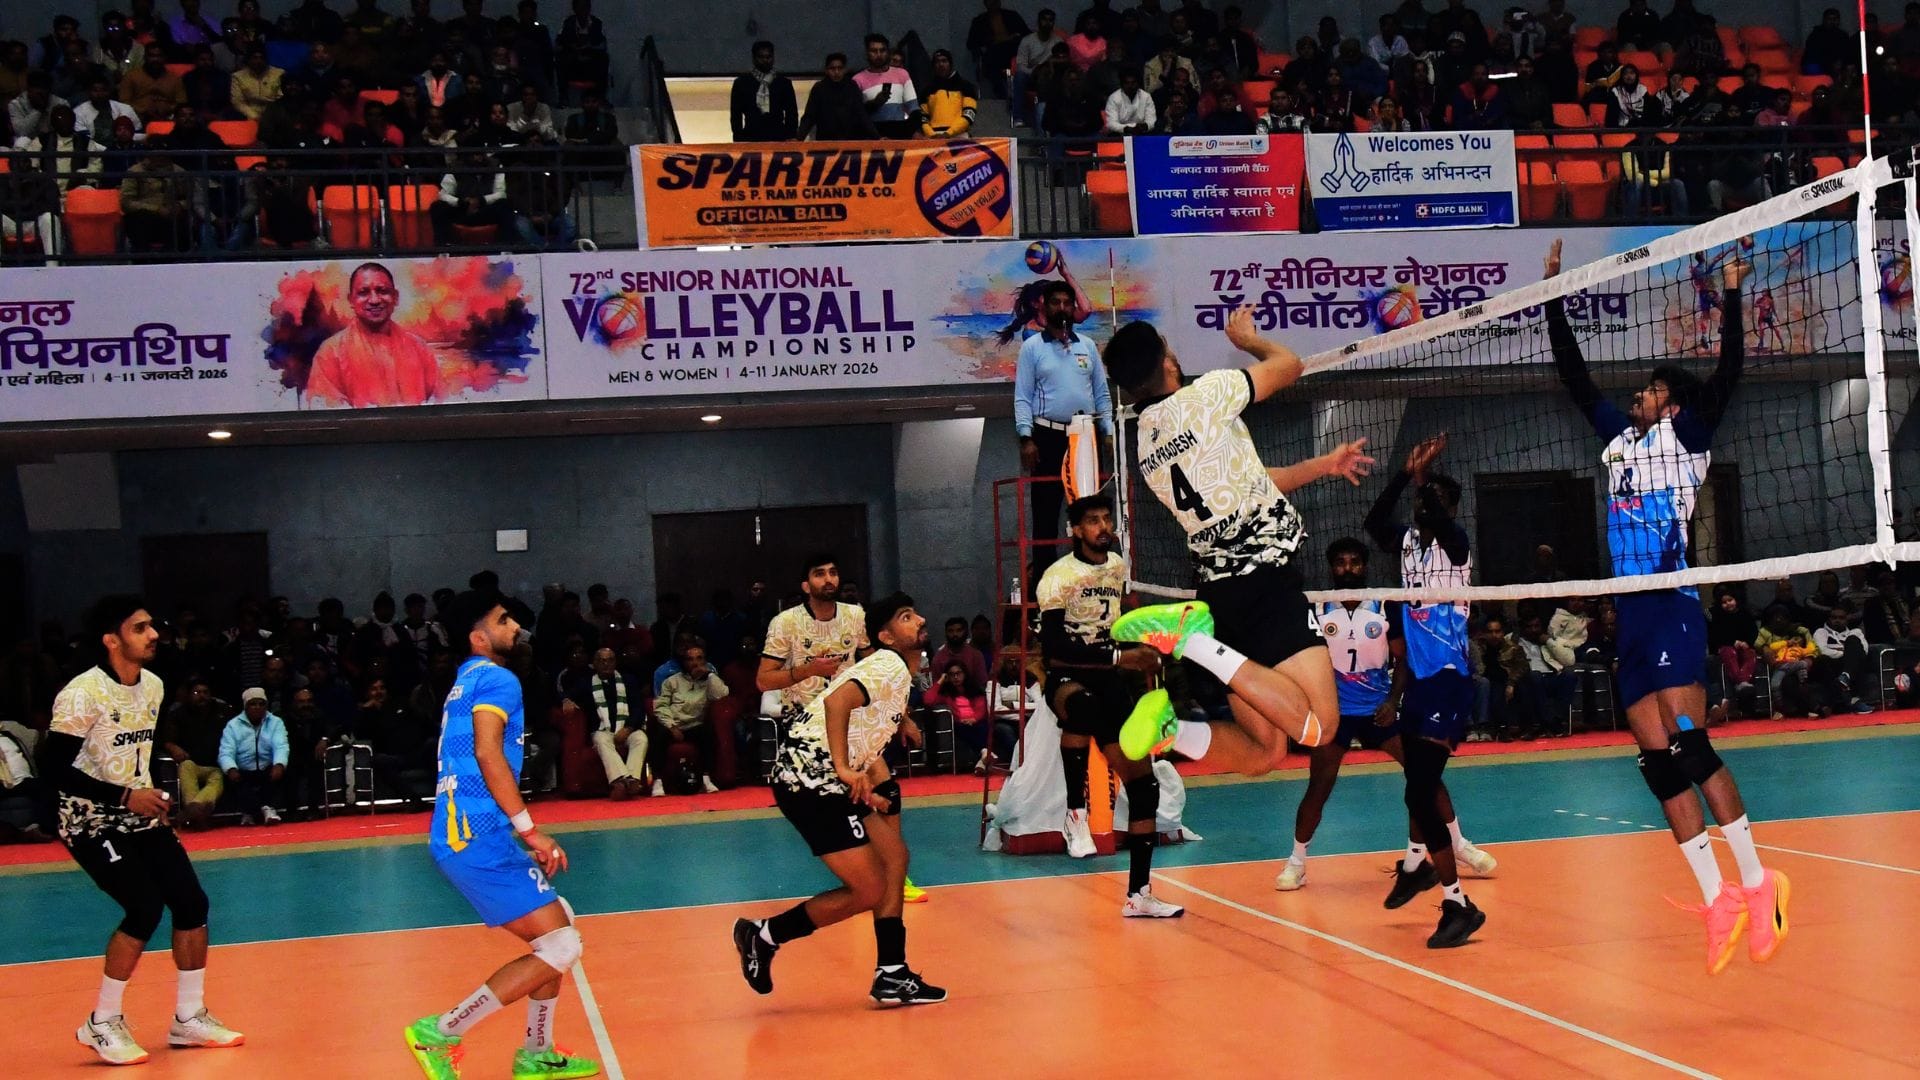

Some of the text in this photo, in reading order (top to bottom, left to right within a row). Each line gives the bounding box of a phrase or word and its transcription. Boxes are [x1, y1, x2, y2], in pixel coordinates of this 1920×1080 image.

[1368, 133, 1491, 153] Welcomes You
[657, 148, 905, 190] SPARTAN
[1370, 160, 1492, 185] हार्दिक अभिनन्दन
[721, 186, 896, 201] M/S P. RAM CHAND & CO.
[933, 163, 993, 211] SPARTAN
[1147, 184, 1296, 200] आपका हार्दिक स्वागत एवं
[1811, 177, 1845, 198] SPARTAN
[702, 205, 843, 224] OFFICIAL BALL
[1170, 202, 1276, 218] अभिनंदन करता है
[1431, 205, 1484, 215] HDFC BANK
[569, 266, 853, 295] 72nd SENIOR NATIONAL
[1263, 257, 1387, 291] सीनियर
[1394, 256, 1508, 286] नेशनल
[0, 300, 75, 327] नल
[0, 323, 231, 370] पियनशिप
[641, 335, 917, 361] CHAMPIONSHIP
[7, 371, 32, 386] एवं
[34, 370, 85, 386] महिला
[104, 372, 135, 383] 4-11
[140, 366, 194, 381] जनवरी
[198, 368, 228, 380] 2026
[608, 371, 640, 384] MEN
[659, 367, 718, 381] WOMEN
[739, 366, 766, 378] 4-11
[772, 363, 838, 378] JANUARY
[843, 362, 879, 375] 2026
[1139, 428, 1198, 477] TTAR PRADESH
[1170, 463, 1213, 522] 4
[1081, 587, 1120, 598] SPARTA
[1099, 599, 1110, 621] 7
[1307, 609, 1323, 637] 4
[1347, 648, 1357, 673] 7
[134, 747, 141, 777] 1
[848, 815, 865, 839] 5
[102, 839, 122, 863] 1
[447, 994, 490, 1030] UNDR
[537, 1003, 549, 1048] ARMR
